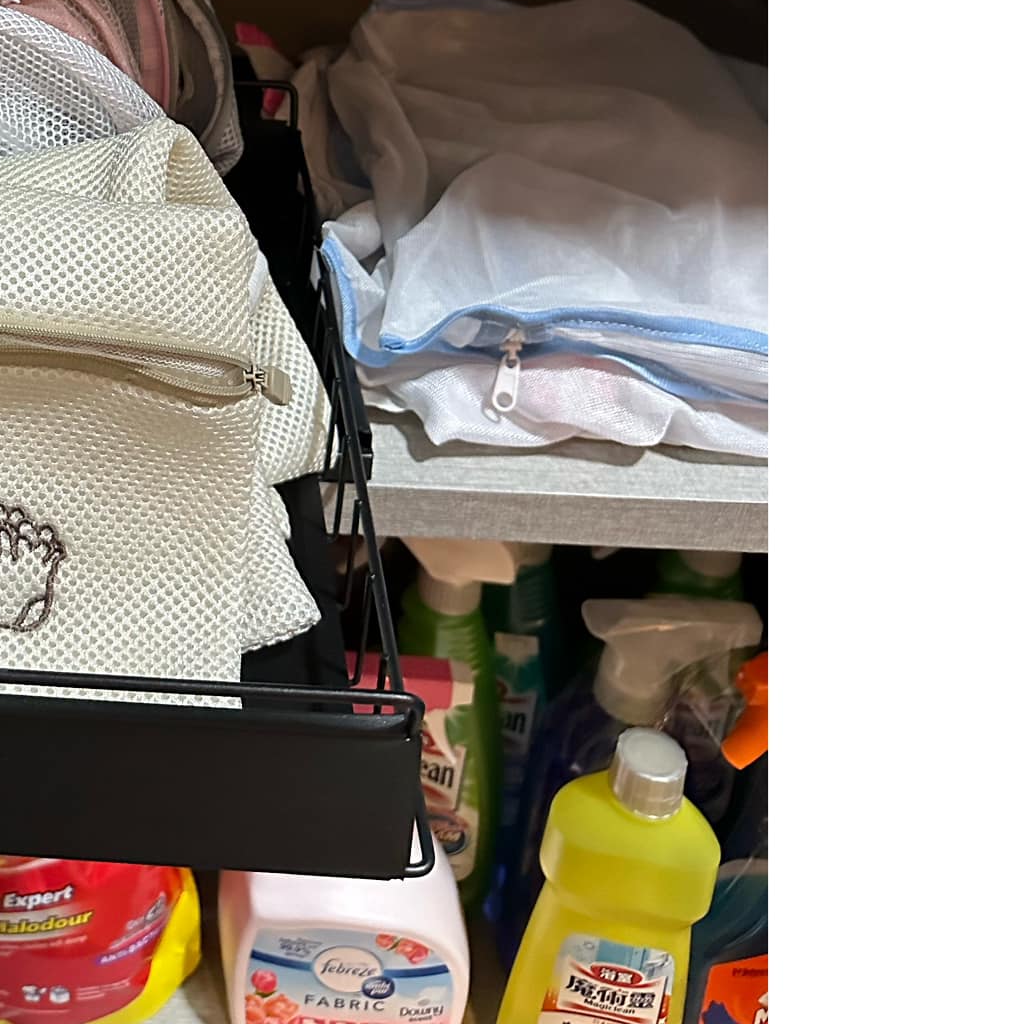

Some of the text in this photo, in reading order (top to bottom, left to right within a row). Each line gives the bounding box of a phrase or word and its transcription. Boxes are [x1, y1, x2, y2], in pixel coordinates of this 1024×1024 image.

[3, 884, 75, 910] Expert
[320, 958, 377, 977] febreze
[304, 994, 386, 1012] FABRIC
[399, 1005, 445, 1018] Downy
